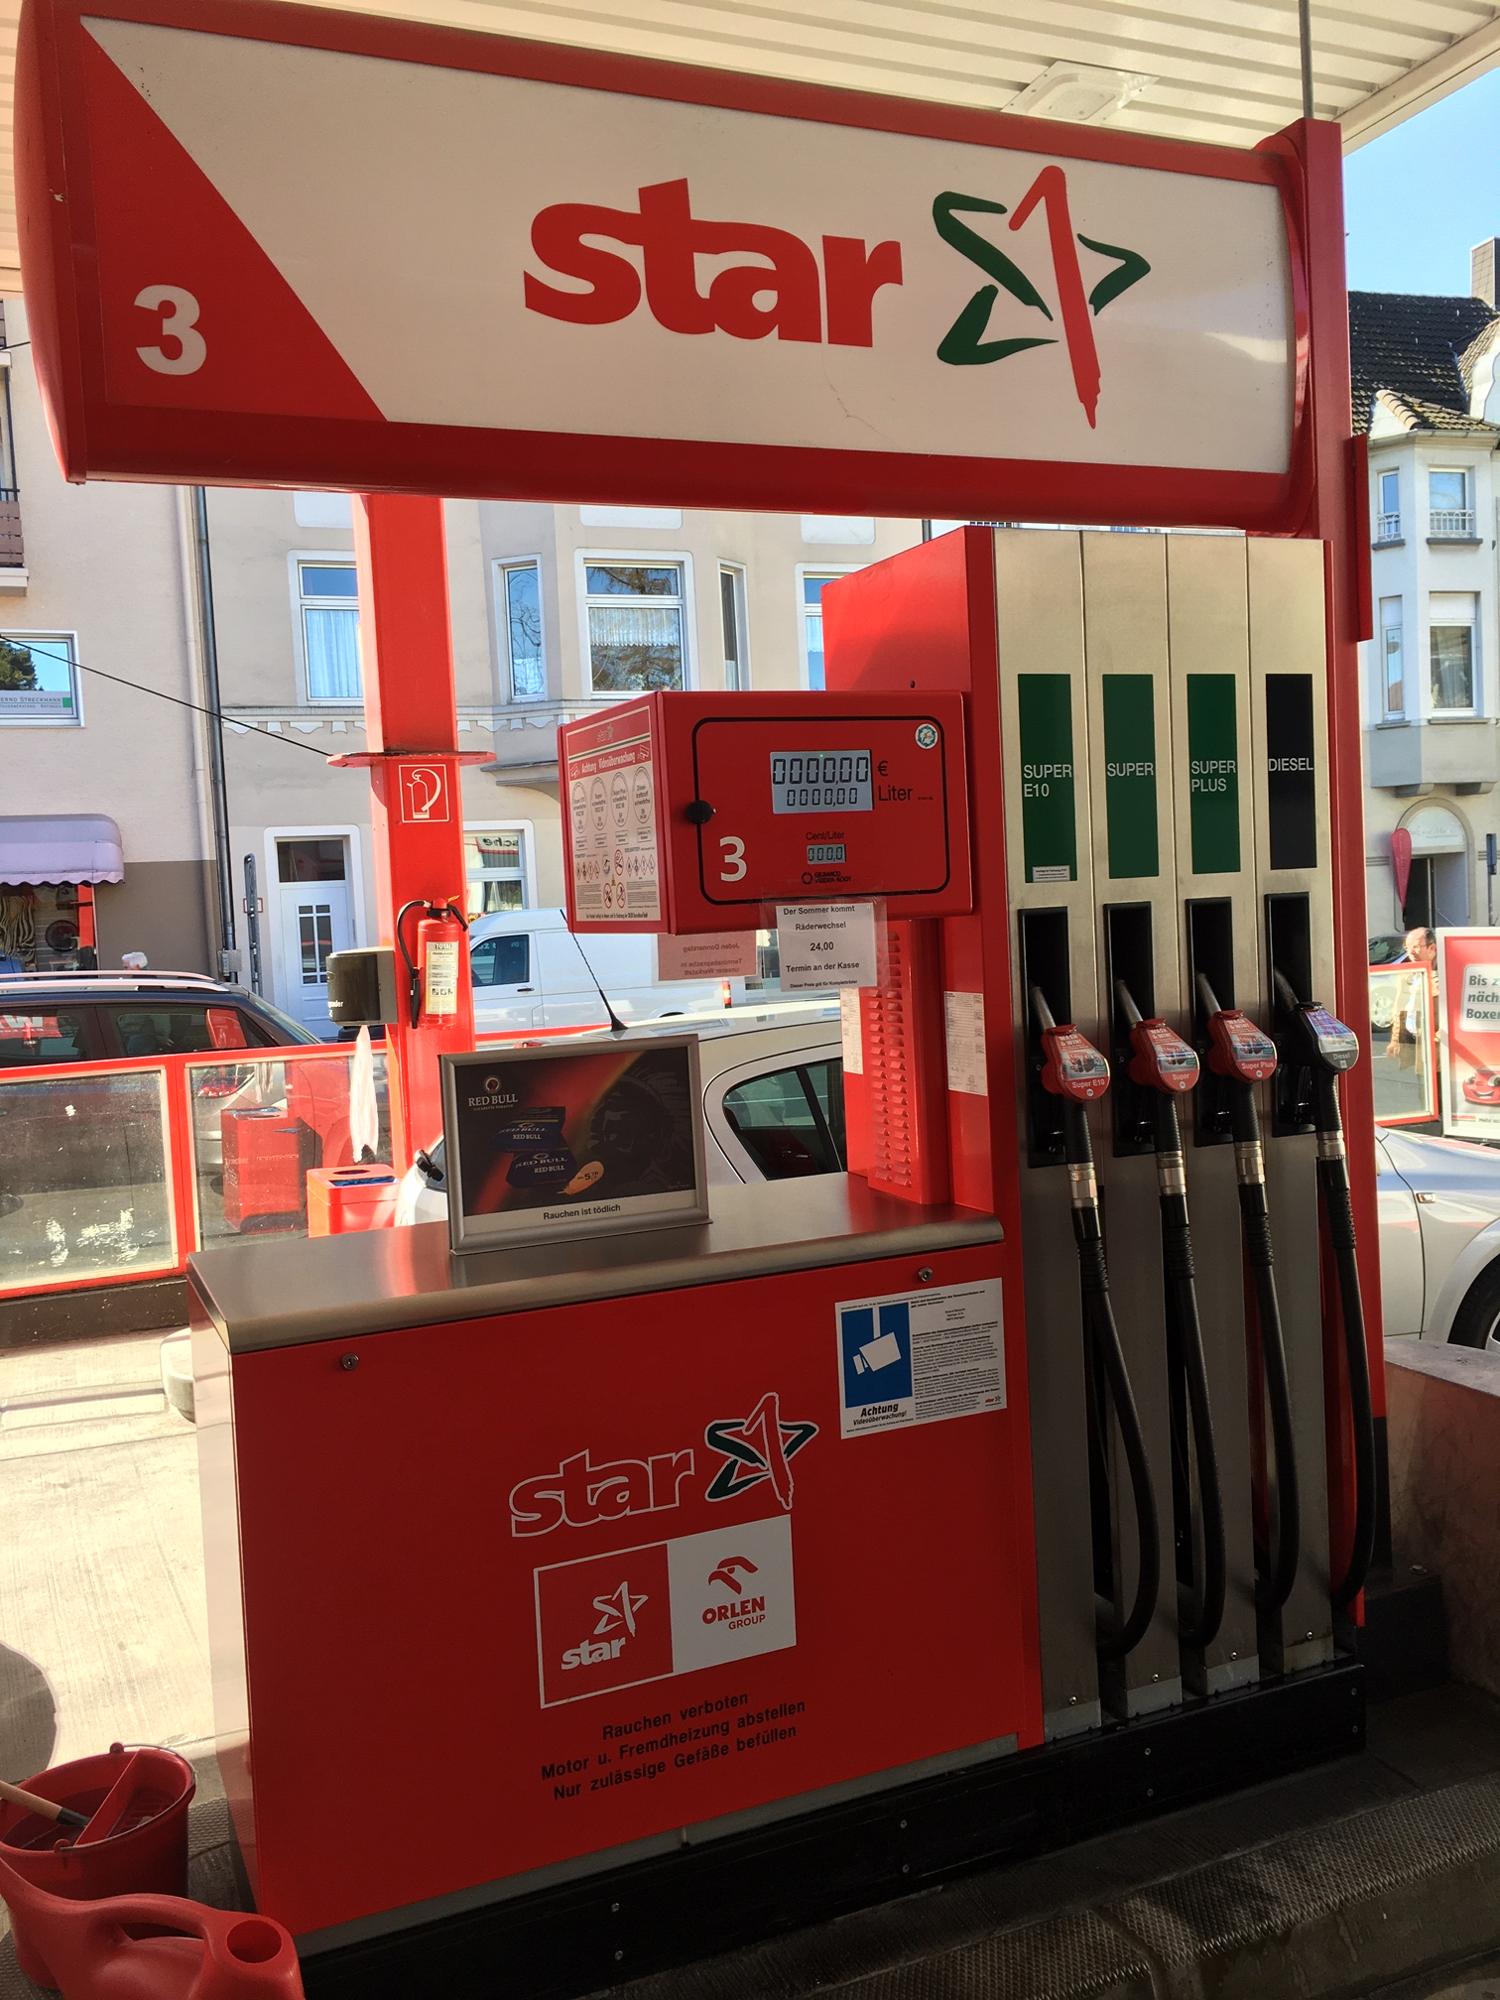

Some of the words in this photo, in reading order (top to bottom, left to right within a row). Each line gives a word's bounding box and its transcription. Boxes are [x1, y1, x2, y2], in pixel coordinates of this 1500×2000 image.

[523, 177, 904, 348] star
[133, 283, 207, 377] 3
[773, 757, 869, 785] 0000,00
[877, 761, 888, 776] €
[1023, 764, 1073, 778] SUPER
[1106, 762, 1154, 777] SUPER
[1191, 760, 1237, 774] SUPER
[1268, 757, 1314, 772] DIESEL
[1024, 783, 1050, 798] E10
[1191, 778, 1227, 792] PLUS
[787, 788, 857, 806] 0000,00
[878, 785, 913, 801] Liter
[806, 831, 845, 841] Cent/Liter
[719, 836, 748, 882] 3
[783, 907, 797, 916] Der
[798, 906, 829, 915] Sommer
[830, 905, 855, 913] kommt
[795, 921, 847, 932] Räderwechsel
[810, 942, 834, 952] 24,00
[786, 963, 812, 973] Termin
[823, 962, 836, 971] der
[837, 961, 860, 970] Kasse
[1469, 975, 1488, 986] Bis
[1467, 991, 1500, 1002] näch
[1241, 1062, 1259, 1070] Super
[1260, 1060, 1274, 1068] Plus
[1072, 1080, 1091, 1089] Super
[1092, 1078, 1105, 1087] E10
[468, 1096, 490, 1107] RED
[492, 1093, 519, 1105] BULL
[543, 1209, 580, 1220] Rauchen
[581, 1207, 592, 1216] ist
[593, 1203, 621, 1214] tödlich
[861, 1403, 899, 1417] Achtung
[853, 1410, 907, 1426] Videoüberwachung!
[509, 1449, 695, 1537] star
[701, 1596, 766, 1625] ORLEN
[728, 1614, 766, 1631] GROUP
[561, 1637, 626, 1670] star
[602, 1711, 672, 1741] Rauchen
[680, 1691, 748, 1721] verboten
[541, 1757, 590, 1781] Motor
[598, 1753, 612, 1765] u.
[619, 1718, 730, 1760] Fremdheizung
[737, 1700, 806, 1731] abstellen
[553, 1781, 582, 1801] Nur
[590, 1760, 666, 1794] zulässige
[674, 1742, 729, 1768] Gefäße
[737, 1725, 797, 1751] befüllen
